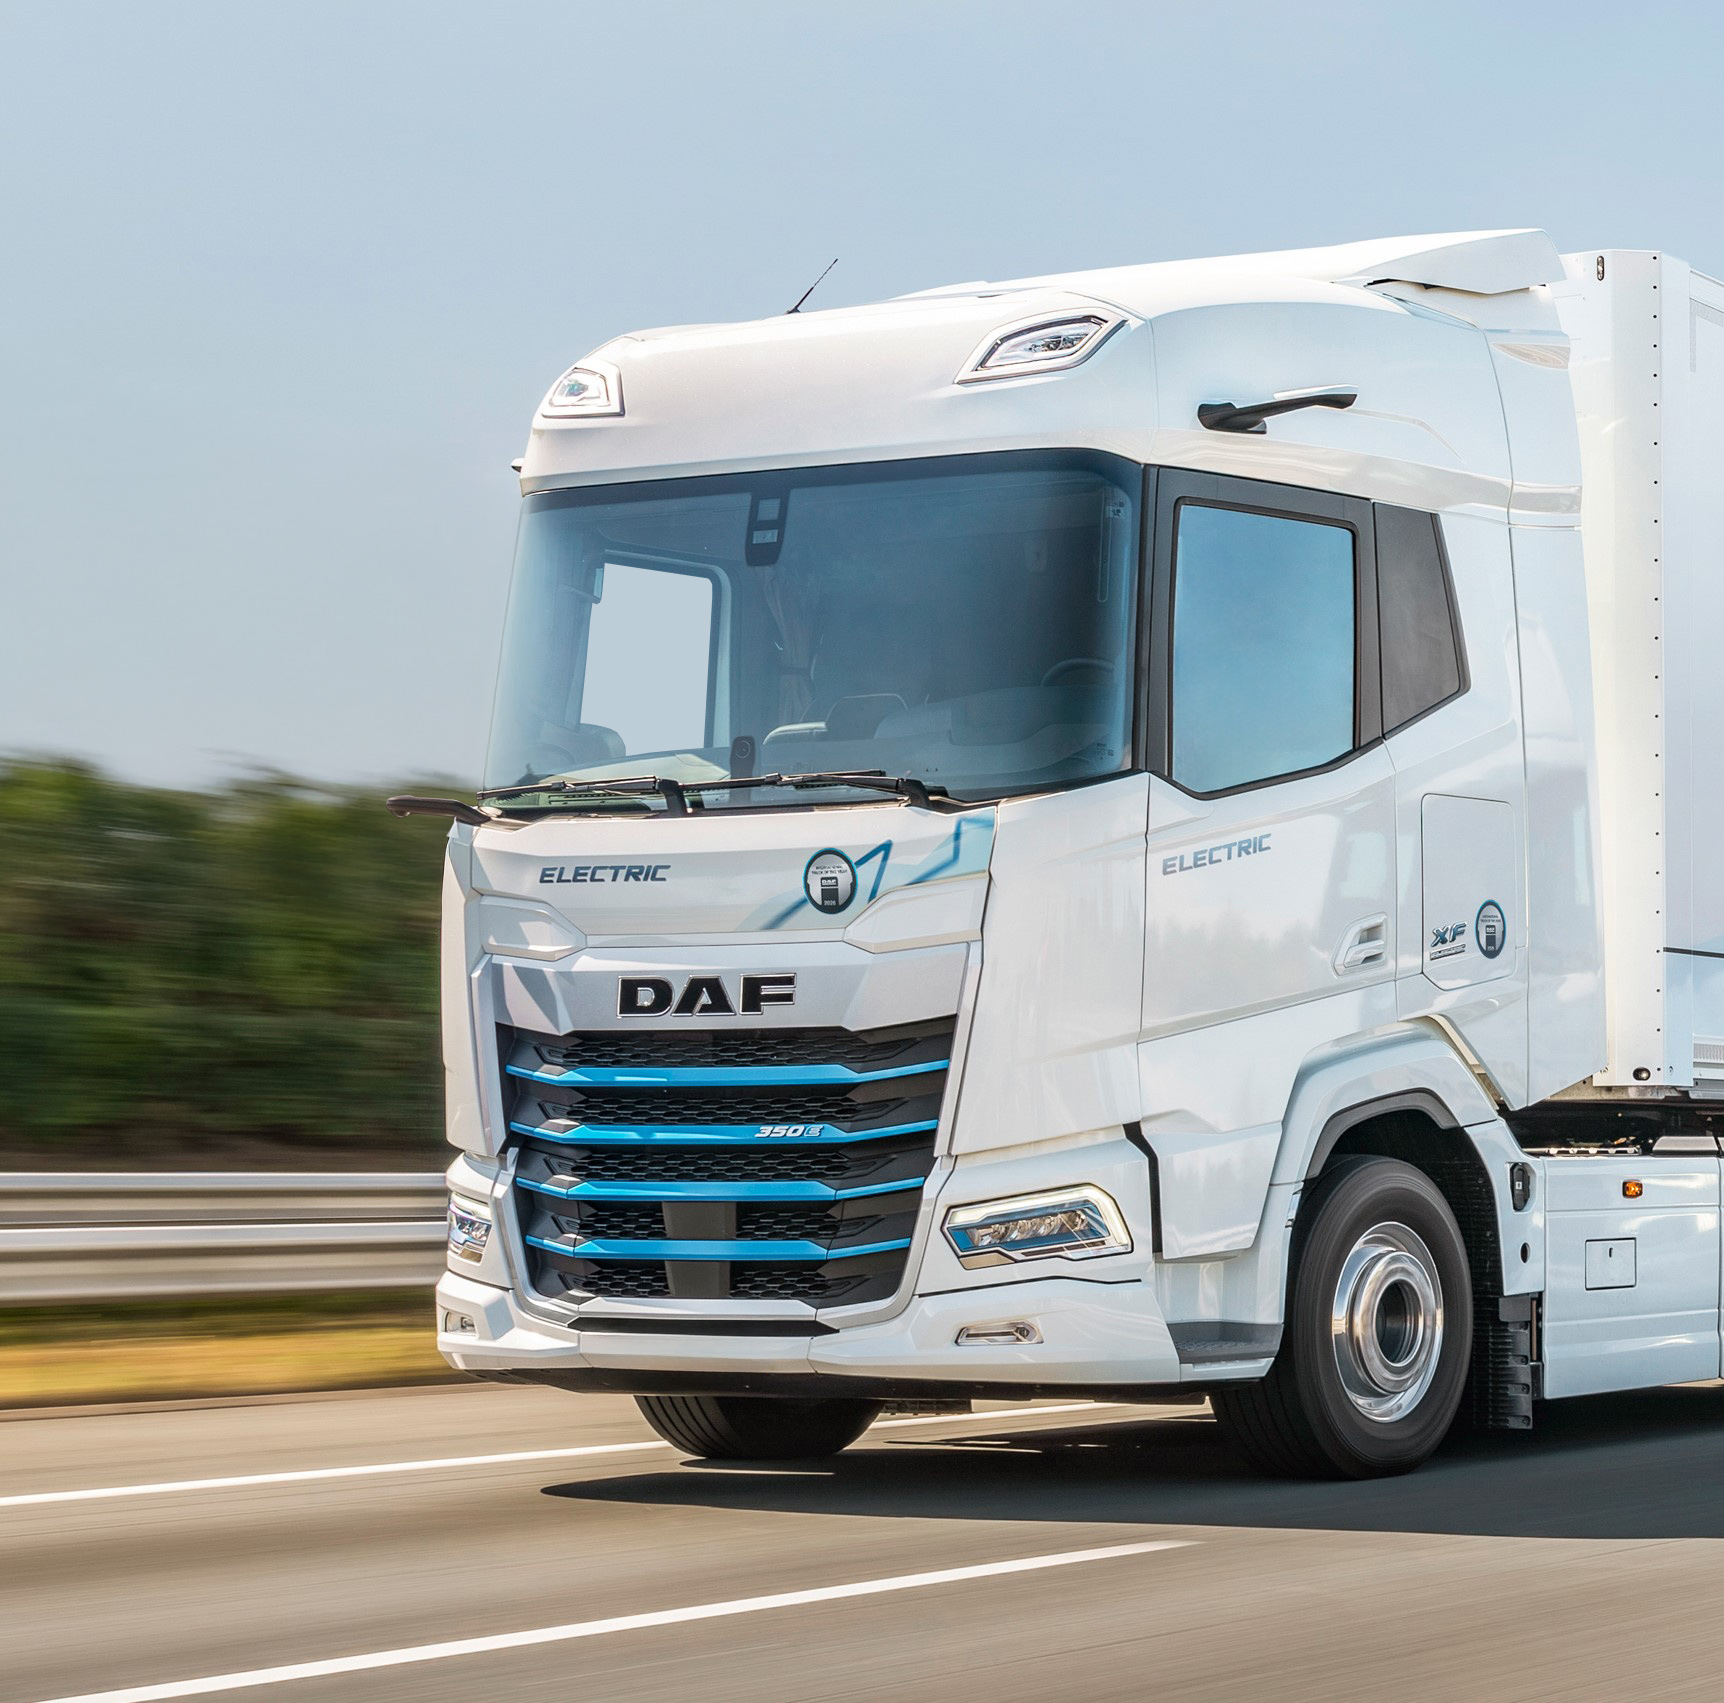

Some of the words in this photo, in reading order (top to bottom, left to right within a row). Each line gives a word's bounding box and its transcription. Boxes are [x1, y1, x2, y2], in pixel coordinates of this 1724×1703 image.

[1162, 833, 1272, 876] ELECTRIC
[539, 864, 671, 884] ELECTRIC
[1430, 921, 1467, 948] XF
[616, 972, 797, 1018] DAF
